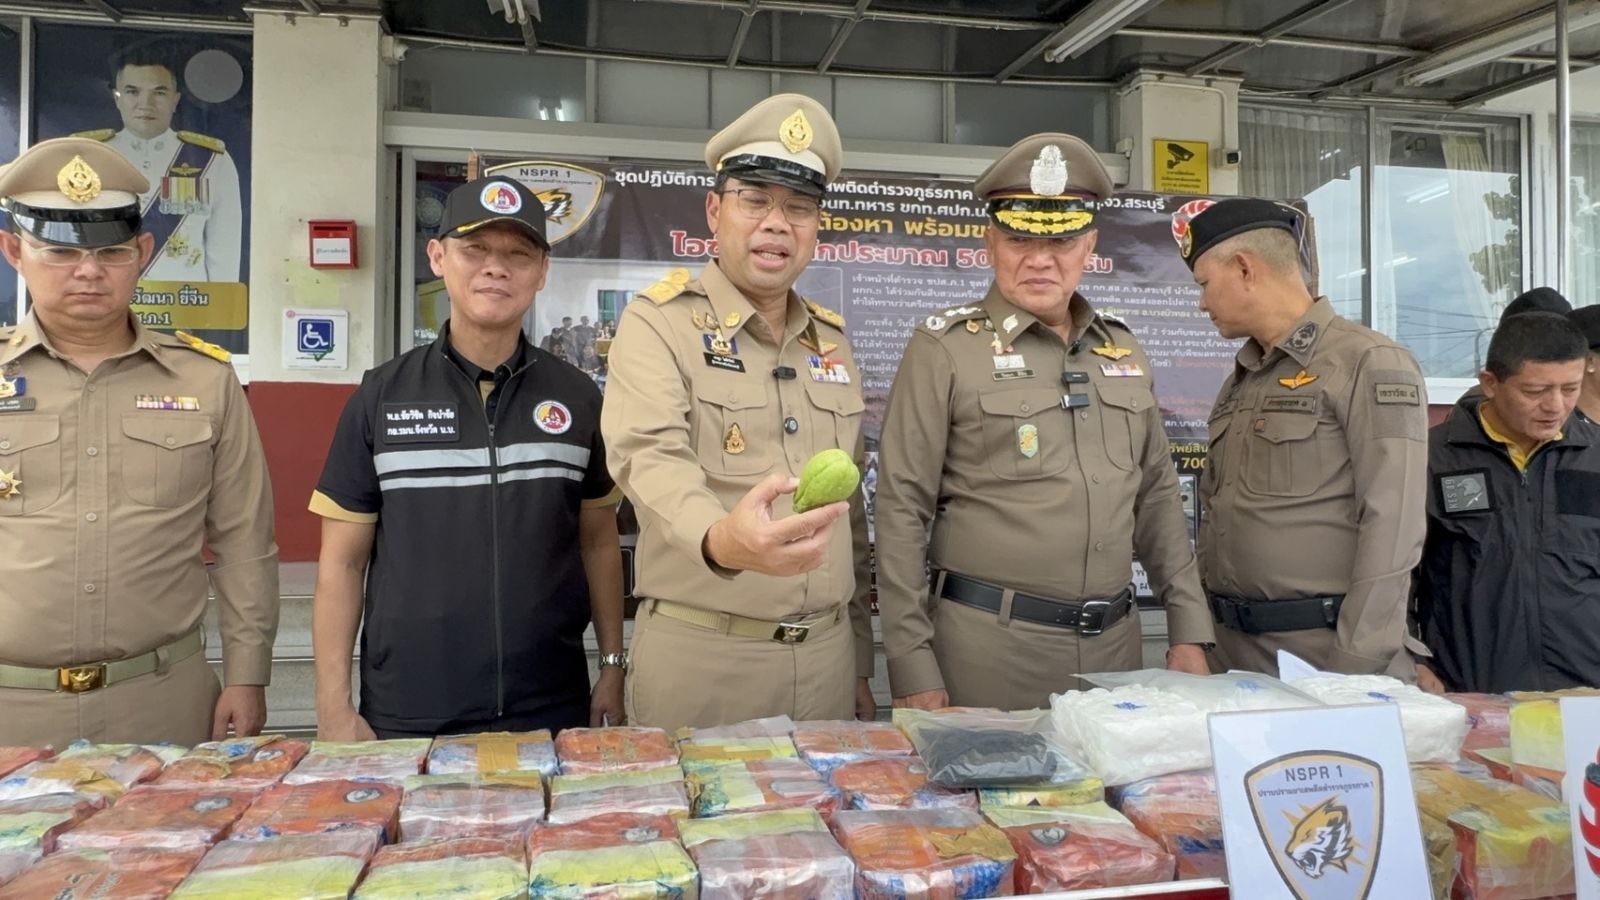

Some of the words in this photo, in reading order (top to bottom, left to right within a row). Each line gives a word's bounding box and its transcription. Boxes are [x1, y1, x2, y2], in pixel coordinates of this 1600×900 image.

[519, 167, 560, 179] NSPR
[566, 170, 572, 179] 1
[615, 169, 716, 188] ชุดปฏิบัติการ
[904, 216, 989, 239] พร้อมข
[669, 230, 720, 258] ไอซ
[1284, 766, 1330, 782] NSPR
[1336, 764, 1343, 778] 1
